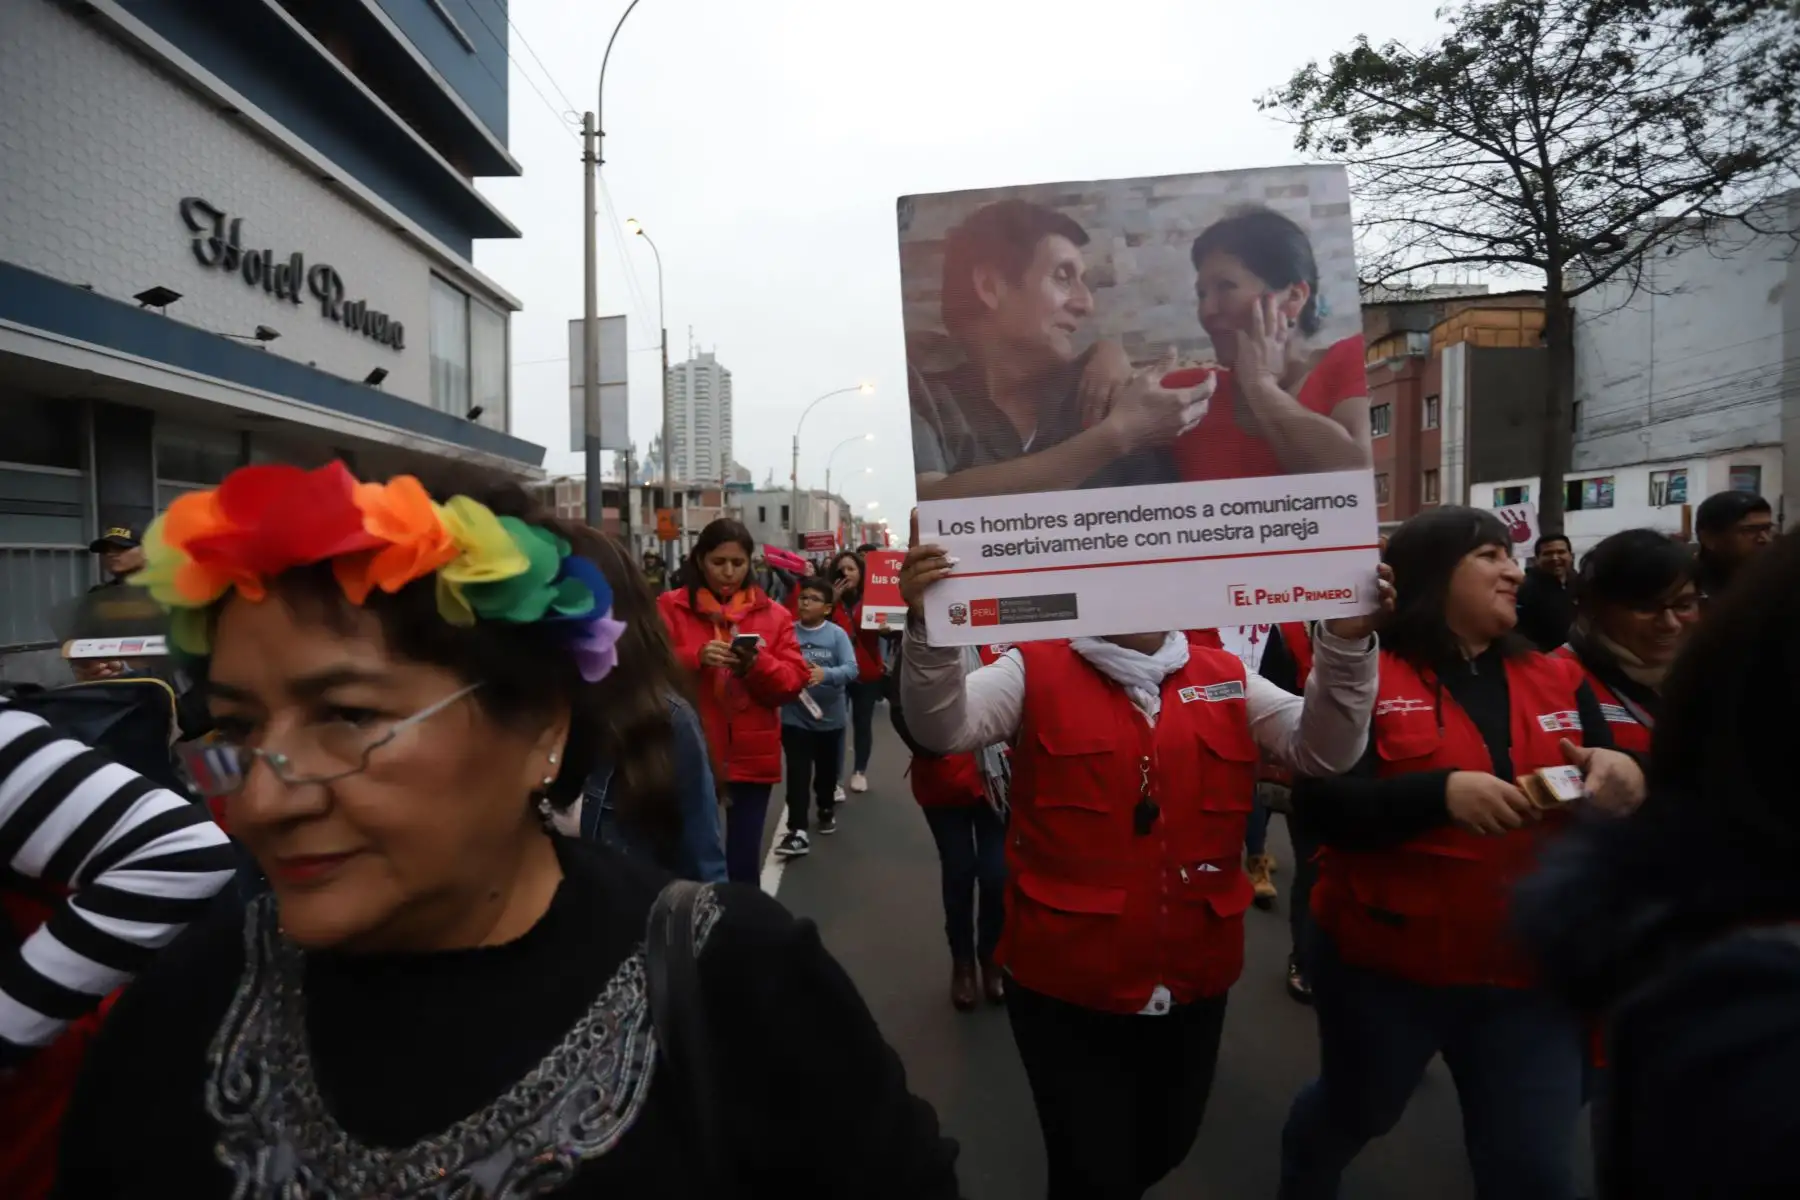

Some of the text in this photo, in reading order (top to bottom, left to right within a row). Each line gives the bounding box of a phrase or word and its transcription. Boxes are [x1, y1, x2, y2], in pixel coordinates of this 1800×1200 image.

[179, 196, 304, 306] Hotel
[938, 519, 975, 536] Los
[980, 513, 1068, 533] hombres
[1073, 504, 1197, 531] aprendemos
[1202, 504, 1214, 517] a
[981, 518, 1319, 557] asertivamente con nuestra pareja
[1292, 586, 1352, 602] PRIMERO
